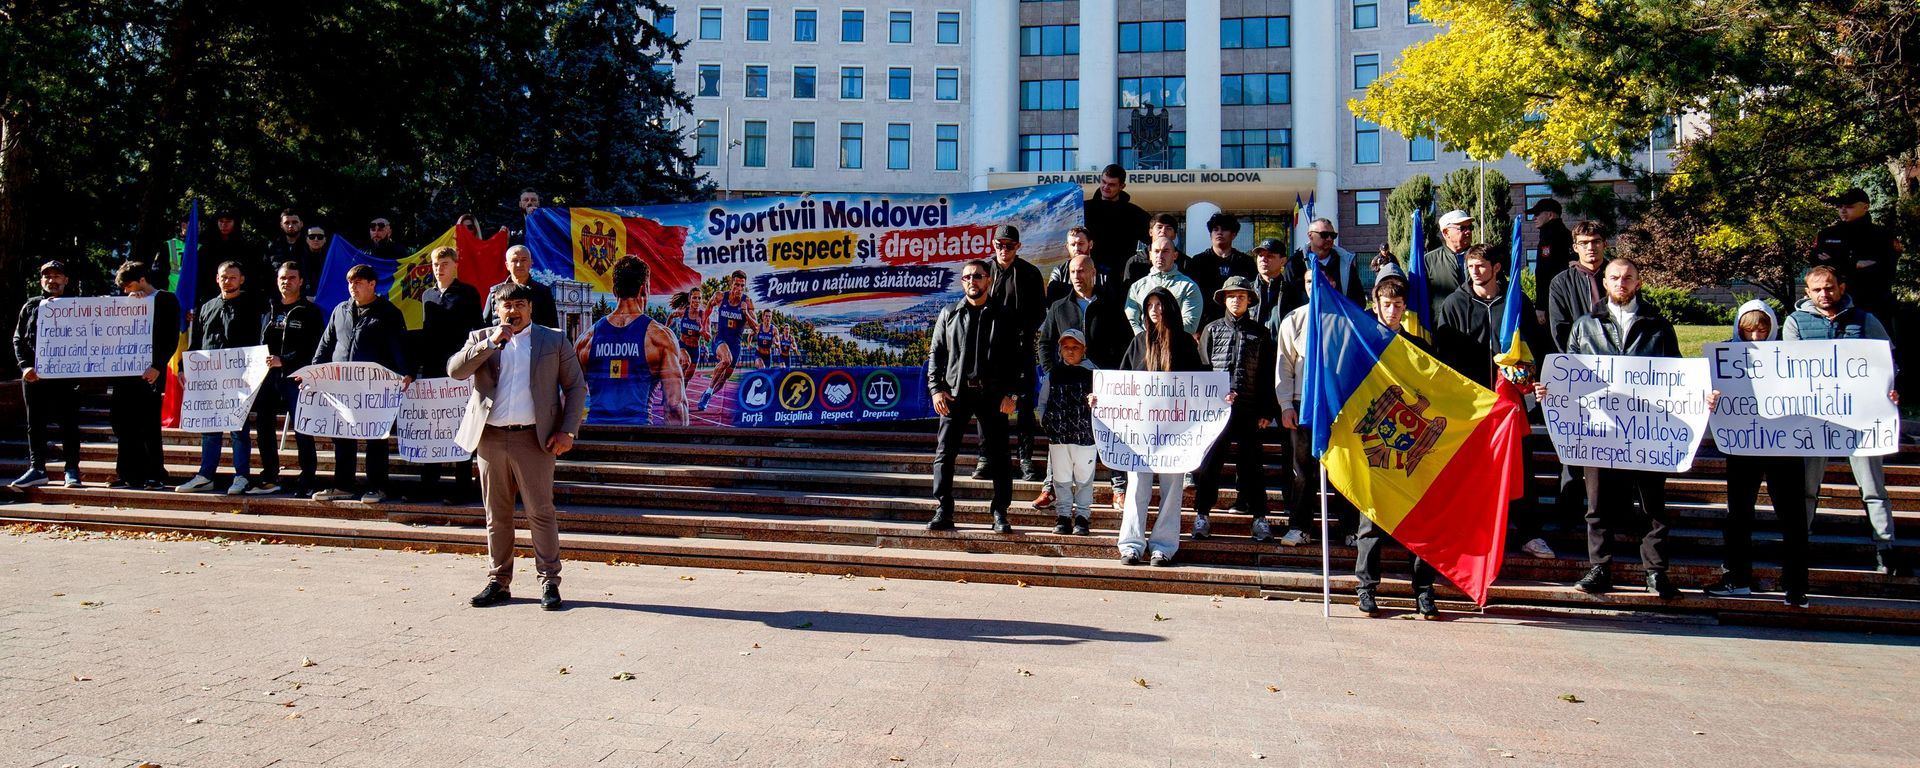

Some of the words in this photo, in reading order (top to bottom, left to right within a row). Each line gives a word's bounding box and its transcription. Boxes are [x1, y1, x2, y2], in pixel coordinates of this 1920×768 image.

[1037, 173, 1100, 185] PARLAMEN
[1129, 173, 1195, 184] REPUBLICII
[1201, 172, 1261, 183] MOLDOVA
[708, 201, 816, 240] Sportivii
[823, 198, 948, 229] Moldovei
[697, 239, 768, 265] merită
[772, 235, 851, 267] respect
[857, 233, 877, 264] și
[884, 228, 994, 264] dreptate!
[767, 279, 809, 298] Pentru
[812, 281, 819, 291] o
[823, 275, 871, 294] națiune
[874, 269, 945, 291] sănătoasă!
[44, 300, 92, 329] Sportivii
[103, 299, 147, 317] antrenorii
[720, 310, 742, 320] MOLDOVA
[40, 320, 73, 337] trebuie
[75, 325, 87, 336] să
[91, 320, 103, 336] fie
[40, 340, 66, 356] atunci
[90, 345, 99, 355] se
[101, 344, 113, 355] iau
[114, 337, 138, 354] decizii
[595, 342, 640, 358] MOLDOVA
[83, 357, 106, 372] direct
[188, 352, 222, 378] Sportul
[1715, 347, 1765, 379] Este
[1773, 344, 1838, 393] timpul
[1846, 357, 1870, 379] ca
[1107, 375, 1140, 396] medalie
[1190, 375, 1199, 397] la
[1204, 384, 1218, 398] un
[1552, 356, 1614, 393] Sportul
[1624, 360, 1686, 397] neolimpic
[398, 403, 428, 420] trebuie
[862, 409, 899, 418] Dreptate
[1092, 400, 1144, 429] campionat
[1148, 399, 1187, 422] mondial
[1188, 408, 1201, 422] nu
[1578, 386, 1620, 417] parte
[1626, 388, 1650, 413] din
[1656, 389, 1706, 422] sportul
[1713, 394, 1759, 416] vocea
[182, 417, 200, 428] care
[297, 406, 311, 432] lor
[333, 410, 344, 436] fie
[741, 412, 763, 424] Forță
[775, 411, 813, 423] Disciplină
[821, 410, 854, 421] Respect
[397, 421, 432, 441] ndiferent
[1094, 428, 1111, 443] mai
[1547, 409, 1607, 444] Republicii
[1615, 415, 1689, 443] Moldova
[1716, 418, 1787, 454] sportive
[1792, 426, 1816, 450] să
[1823, 421, 1842, 450] fie
[431, 446, 447, 458] sau
[1591, 438, 1632, 468] respect
